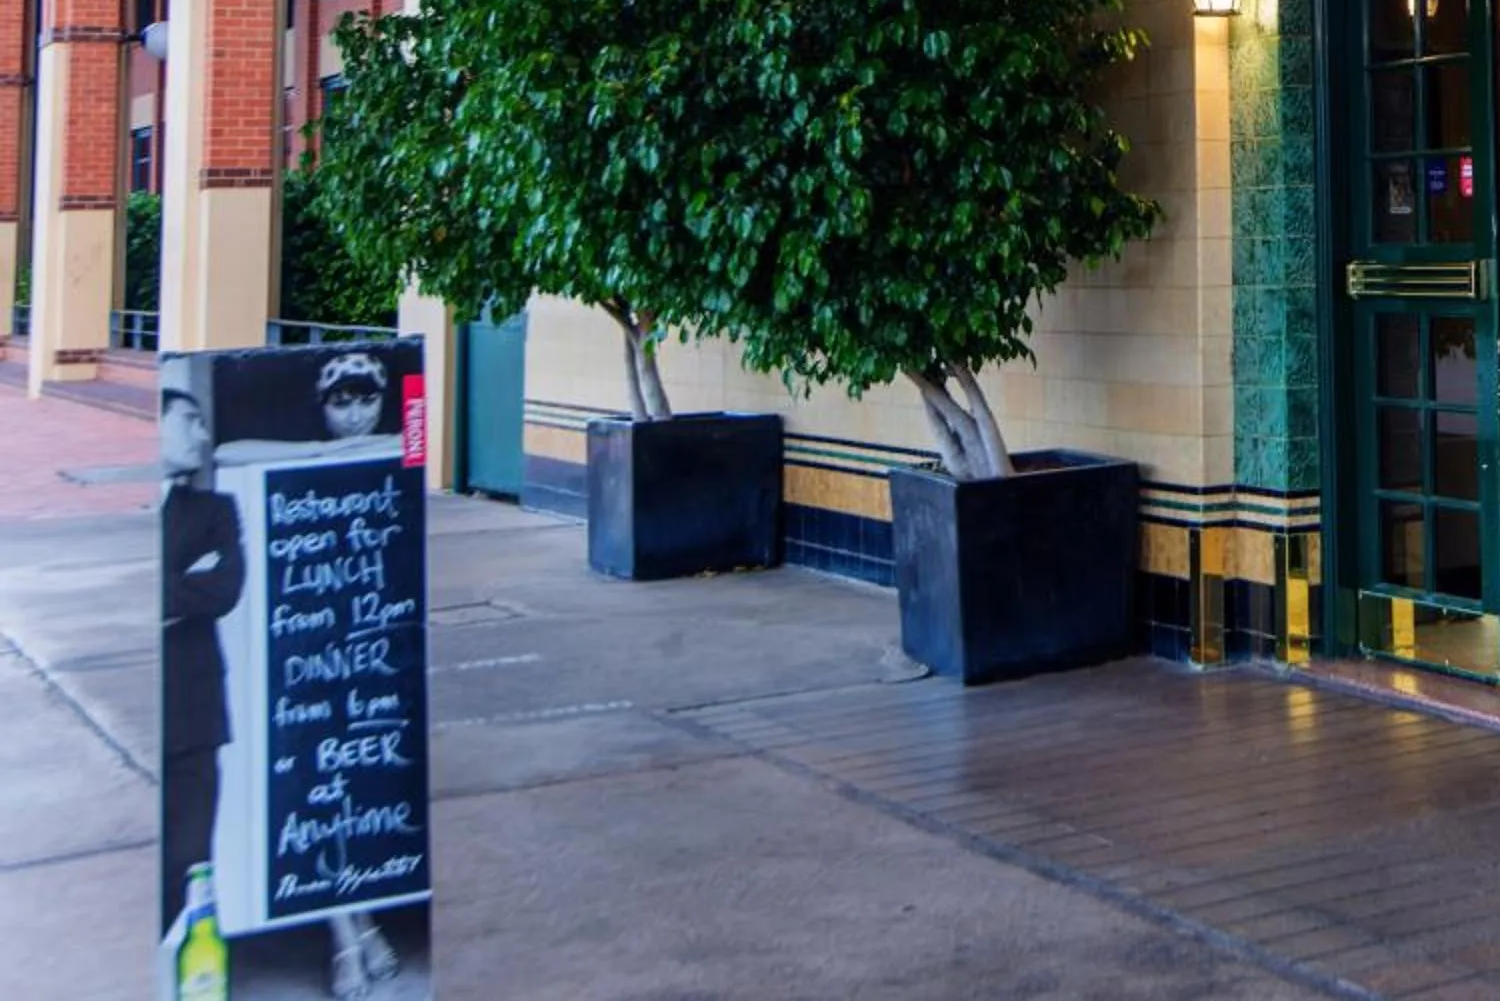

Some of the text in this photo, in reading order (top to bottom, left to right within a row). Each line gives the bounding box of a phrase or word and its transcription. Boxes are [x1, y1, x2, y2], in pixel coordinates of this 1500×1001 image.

[270, 518, 402, 561] open for
[282, 550, 386, 595] LUNCH
[270, 592, 416, 638] from 12pm
[284, 638, 399, 687] DINNER
[272, 697, 331, 727] from
[315, 731, 413, 773] BEER
[307, 772, 350, 804] at
